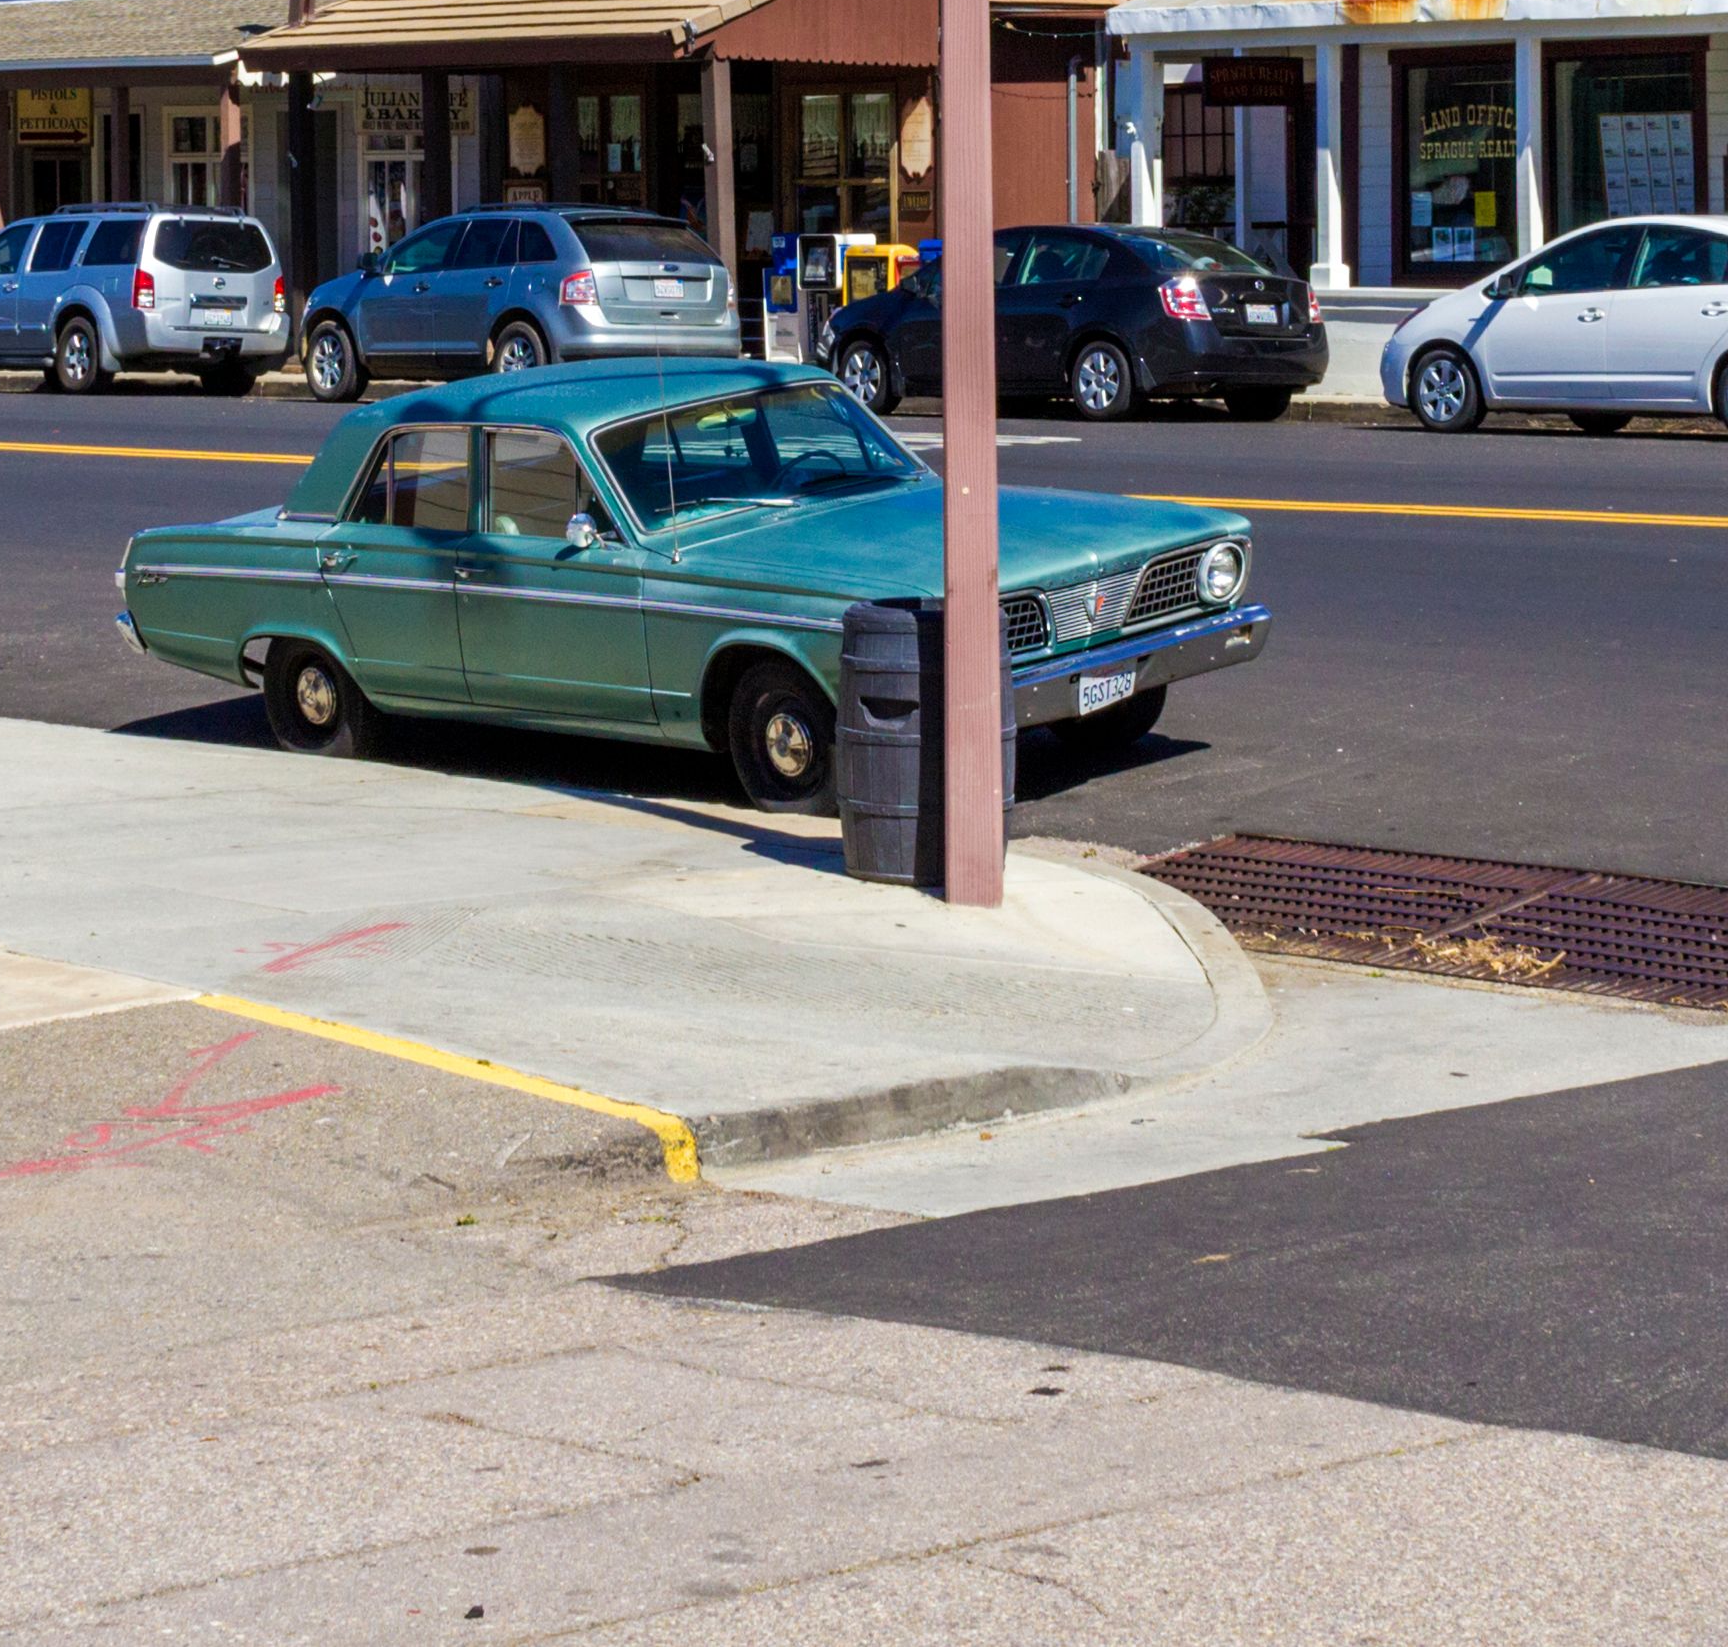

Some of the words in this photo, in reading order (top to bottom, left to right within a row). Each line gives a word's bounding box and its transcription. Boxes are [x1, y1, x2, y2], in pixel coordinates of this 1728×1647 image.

[30, 88, 78, 101] PISTOLS
[361, 87, 420, 108] JULIAN
[20, 117, 88, 130] PETTICOATS
[1420, 106, 1462, 135] LAND
[1466, 104, 1517, 131] OFFIC
[1419, 141, 1474, 160] SPRAGUE
[1479, 139, 1517, 159] REALT
[1082, 671, 1132, 707] 5GST328
